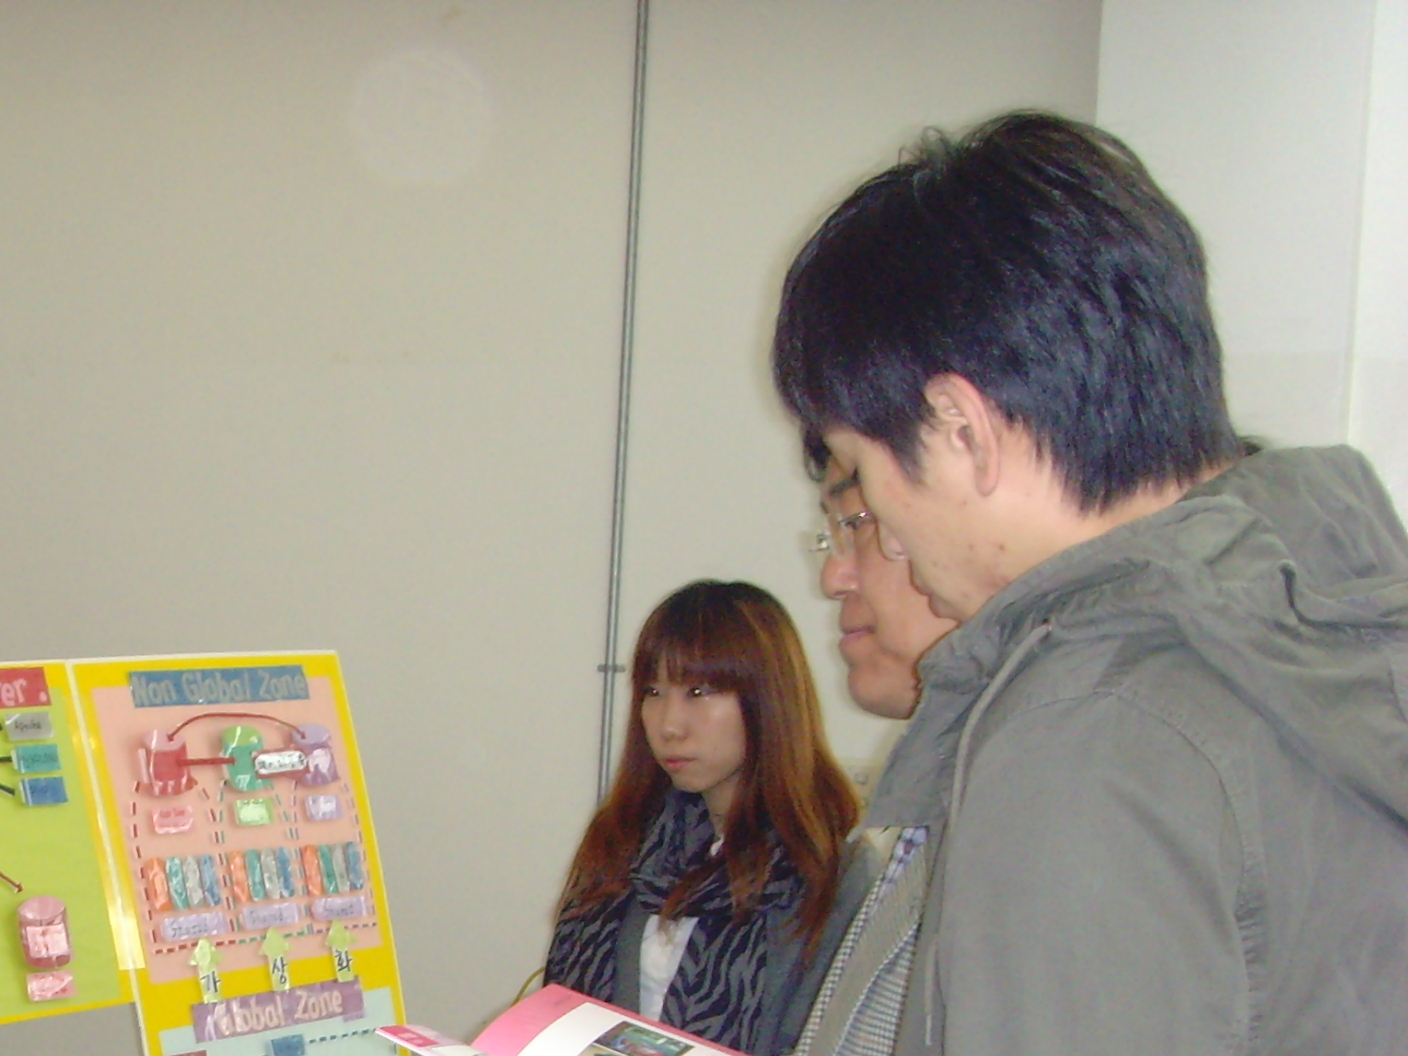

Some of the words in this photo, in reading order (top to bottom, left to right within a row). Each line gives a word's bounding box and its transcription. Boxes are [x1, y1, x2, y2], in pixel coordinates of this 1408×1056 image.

[132, 676, 178, 708] Non
[182, 668, 252, 705] Global
[257, 668, 307, 701] Zone
[200, 971, 221, 994] 가
[272, 956, 289, 985] 상
[335, 949, 354, 972] 화
[213, 994, 286, 1037] Global
[294, 990, 344, 1021] Zone
